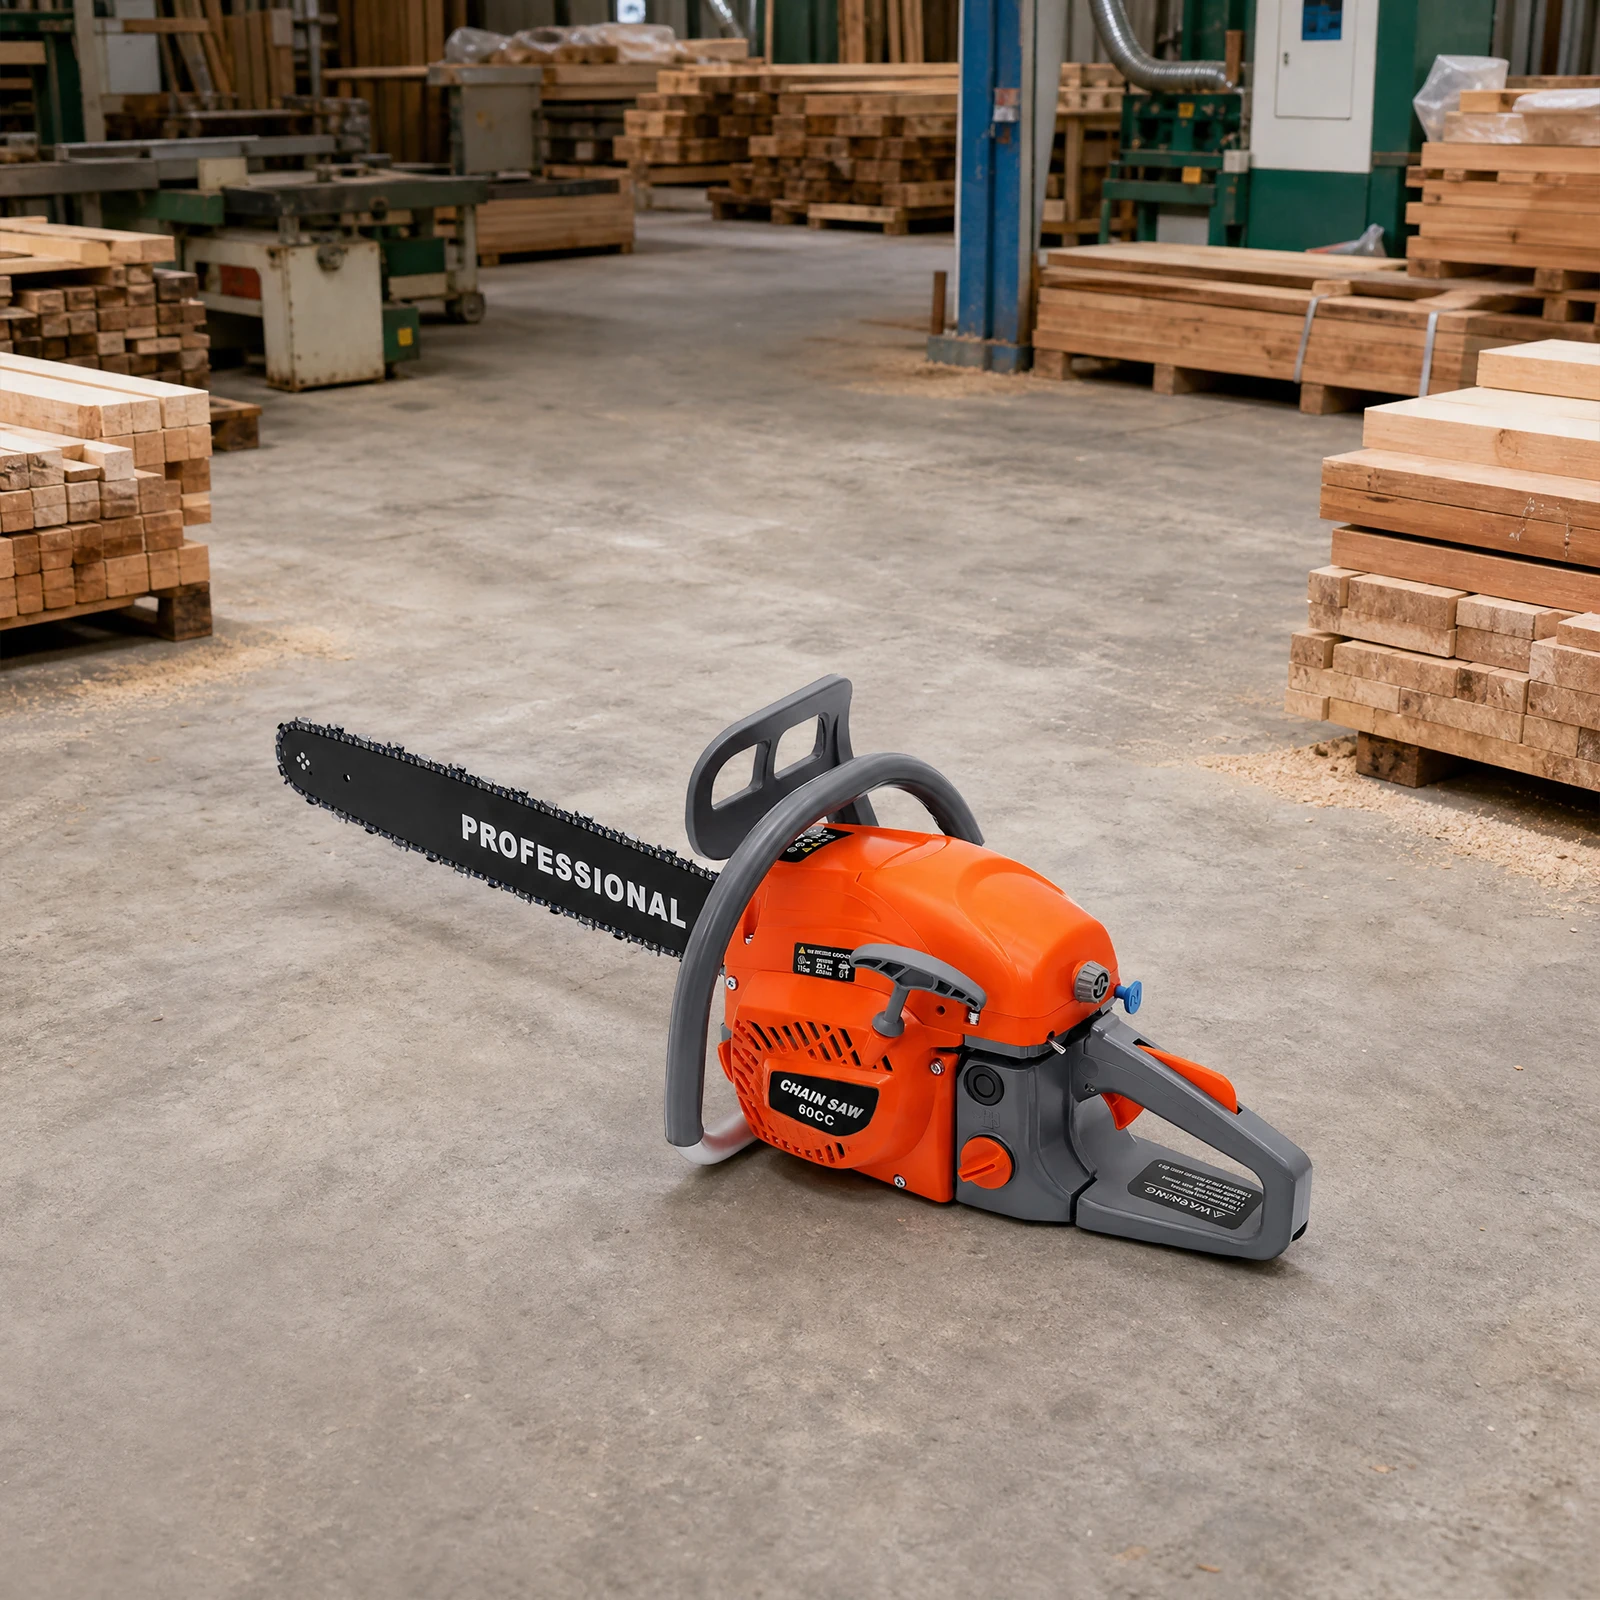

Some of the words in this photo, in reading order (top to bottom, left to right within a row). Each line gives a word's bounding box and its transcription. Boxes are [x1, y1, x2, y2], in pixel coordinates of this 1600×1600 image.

[461, 813, 687, 929] PROFESSIONAL
[780, 1079, 827, 1106] CHAIN
[827, 1098, 864, 1119] SAW
[798, 1103, 835, 1126] 60CC
